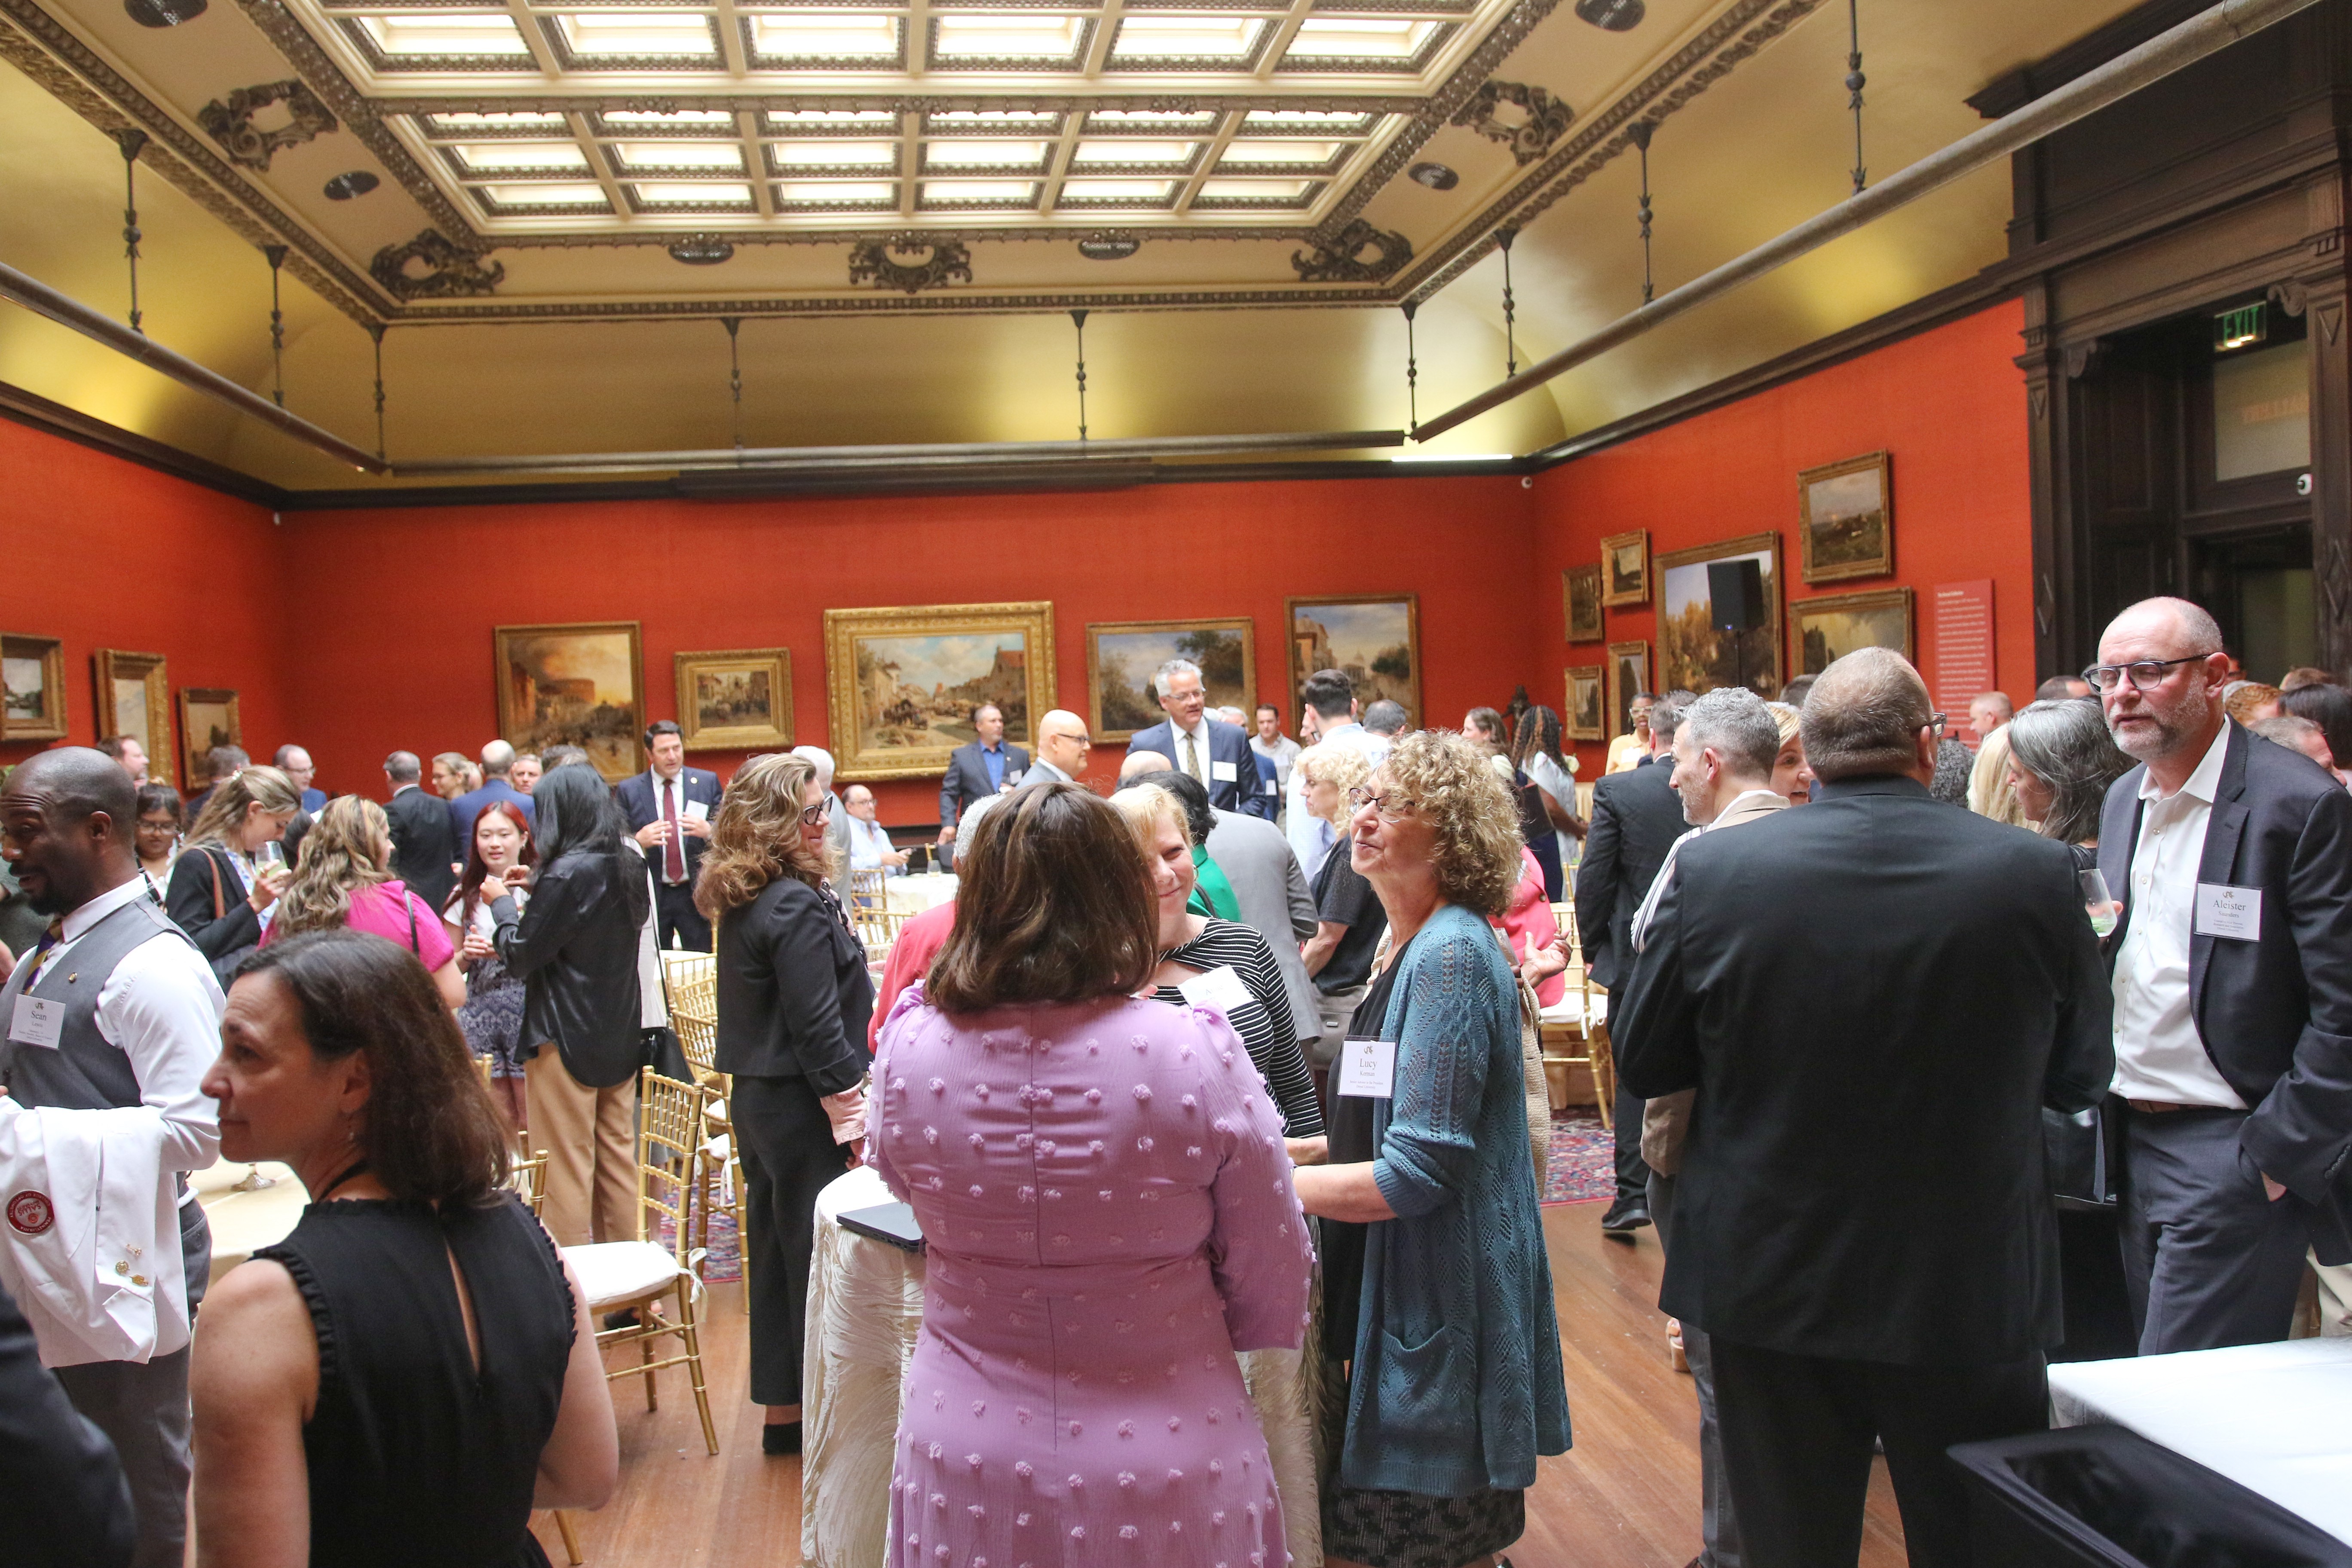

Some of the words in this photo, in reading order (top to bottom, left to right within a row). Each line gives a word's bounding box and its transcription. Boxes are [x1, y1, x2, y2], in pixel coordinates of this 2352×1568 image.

[2223, 306, 2259, 347] EXIT
[2213, 900, 2246, 911] Aleister
[31, 1010, 47, 1021] Sean
[1360, 1058, 1377, 1070] Lucy
[18, 1204, 42, 1216] SALUS
